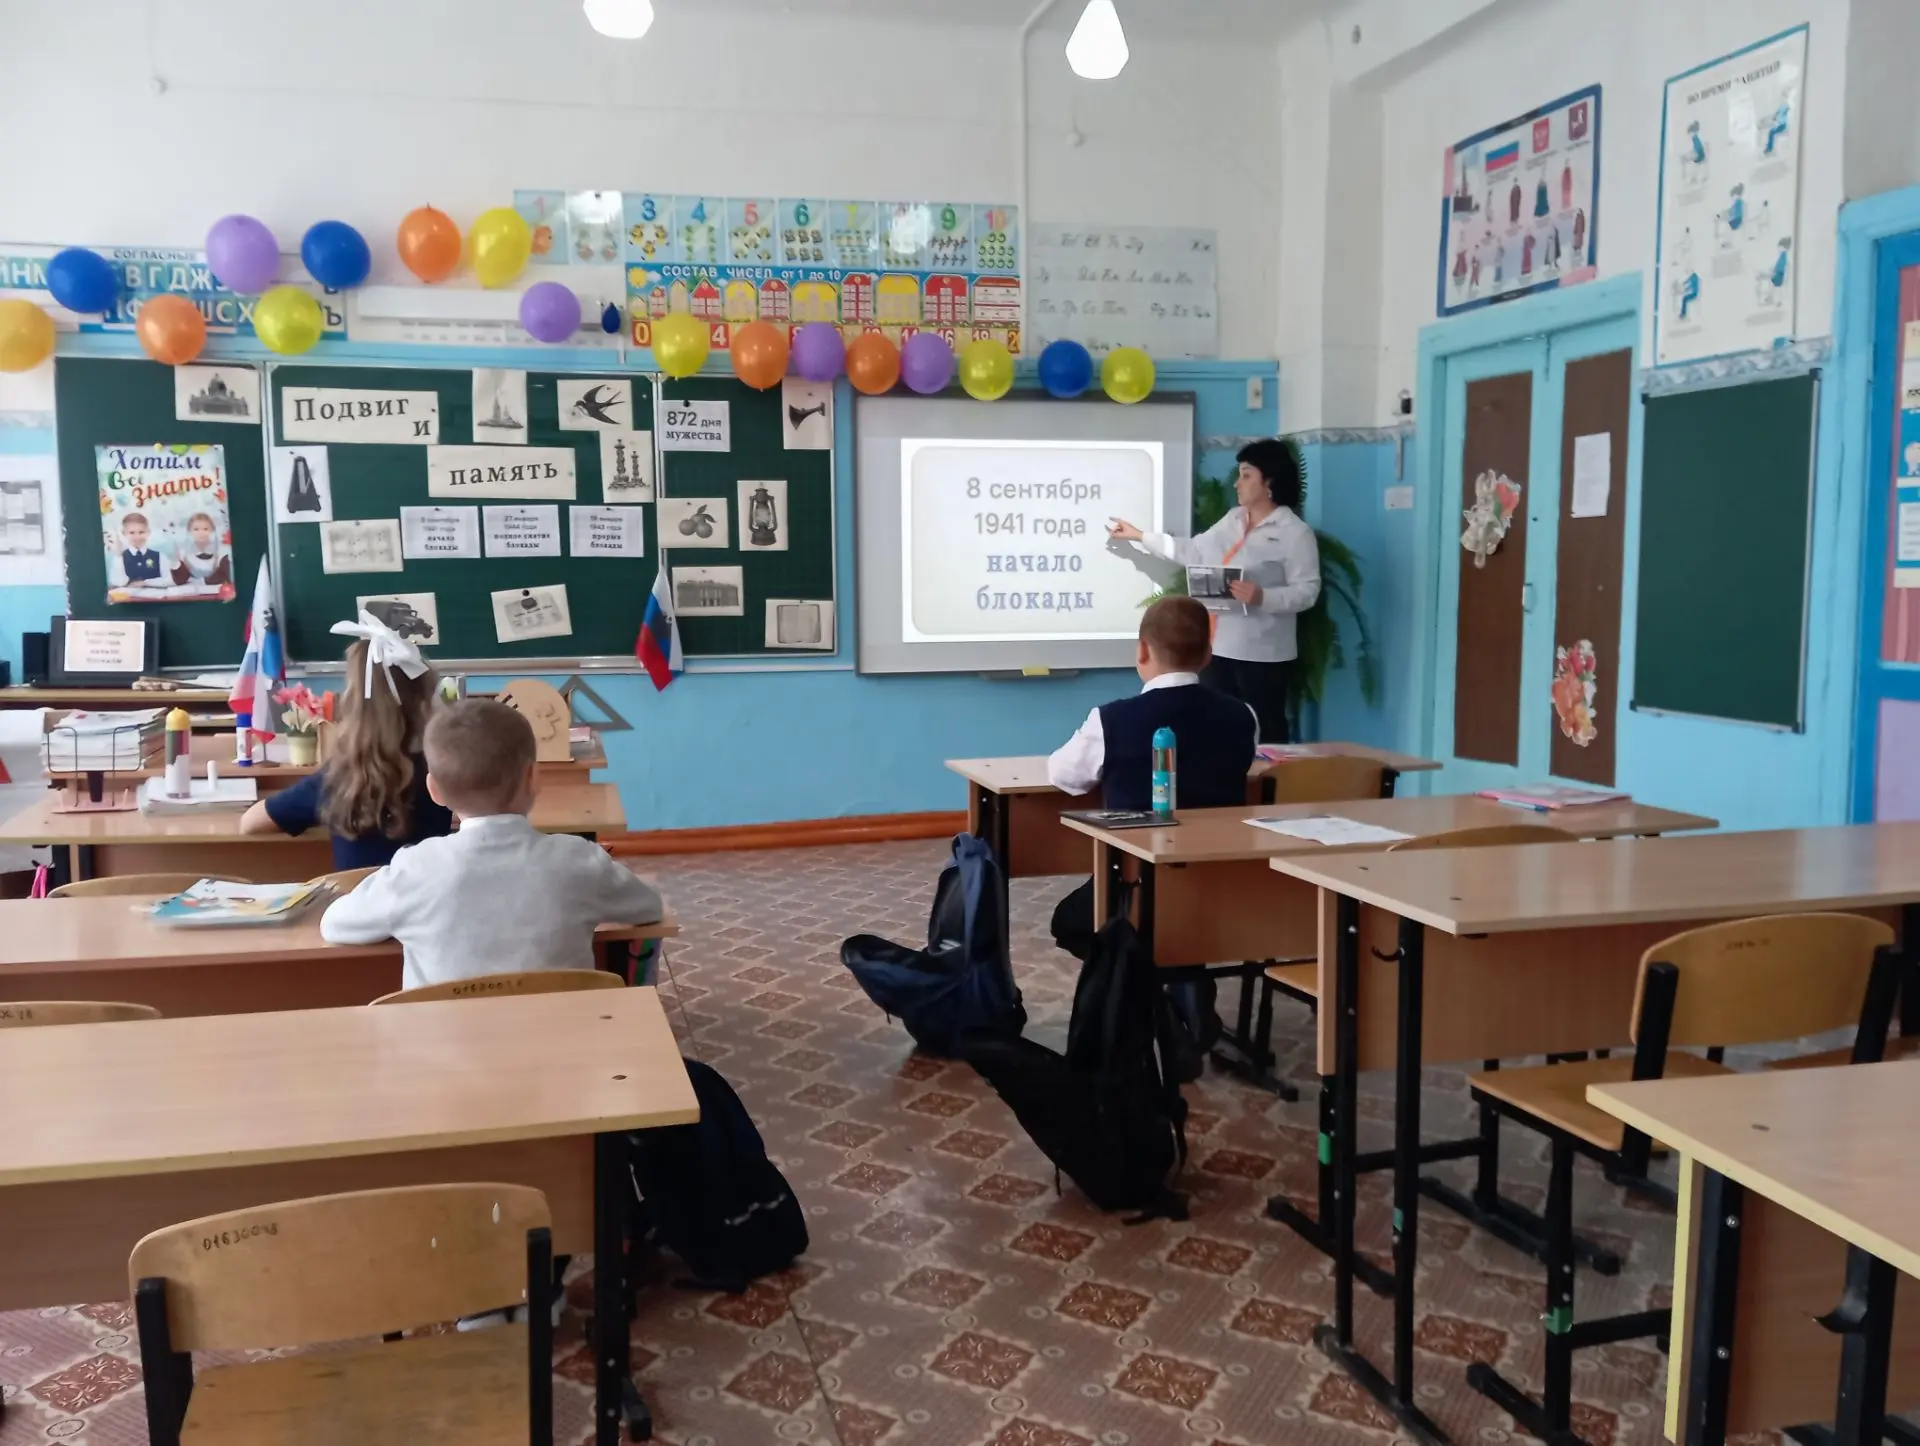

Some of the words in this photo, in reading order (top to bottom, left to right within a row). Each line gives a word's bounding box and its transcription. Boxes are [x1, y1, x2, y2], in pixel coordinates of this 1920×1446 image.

[642, 198, 656, 222] 3
[690, 201, 707, 225] 4
[744, 203, 759, 226] 5
[794, 203, 810, 227] 6
[941, 206, 957, 231] 9
[662, 265, 718, 278] СОСТАВ
[726, 267, 773, 280] ЧИСЕЛ
[827, 270, 841, 281] 10
[635, 323, 648, 344] 0
[712, 325, 727, 345] 4
[293, 398, 410, 422] Подвиг
[666, 411, 698, 427] 872
[701, 418, 722, 429] дня
[413, 419, 432, 437] и
[665, 430, 722, 442] мужества
[109, 449, 203, 470] Хотим
[449, 462, 558, 486] память
[132, 467, 221, 509] знать!
[966, 477, 982, 499] 8
[989, 477, 1102, 505] сентября
[973, 512, 1024, 536] 1941
[1033, 517, 1087, 538] года
[986, 554, 1083, 573] начало
[976, 585, 1095, 612] блокады
